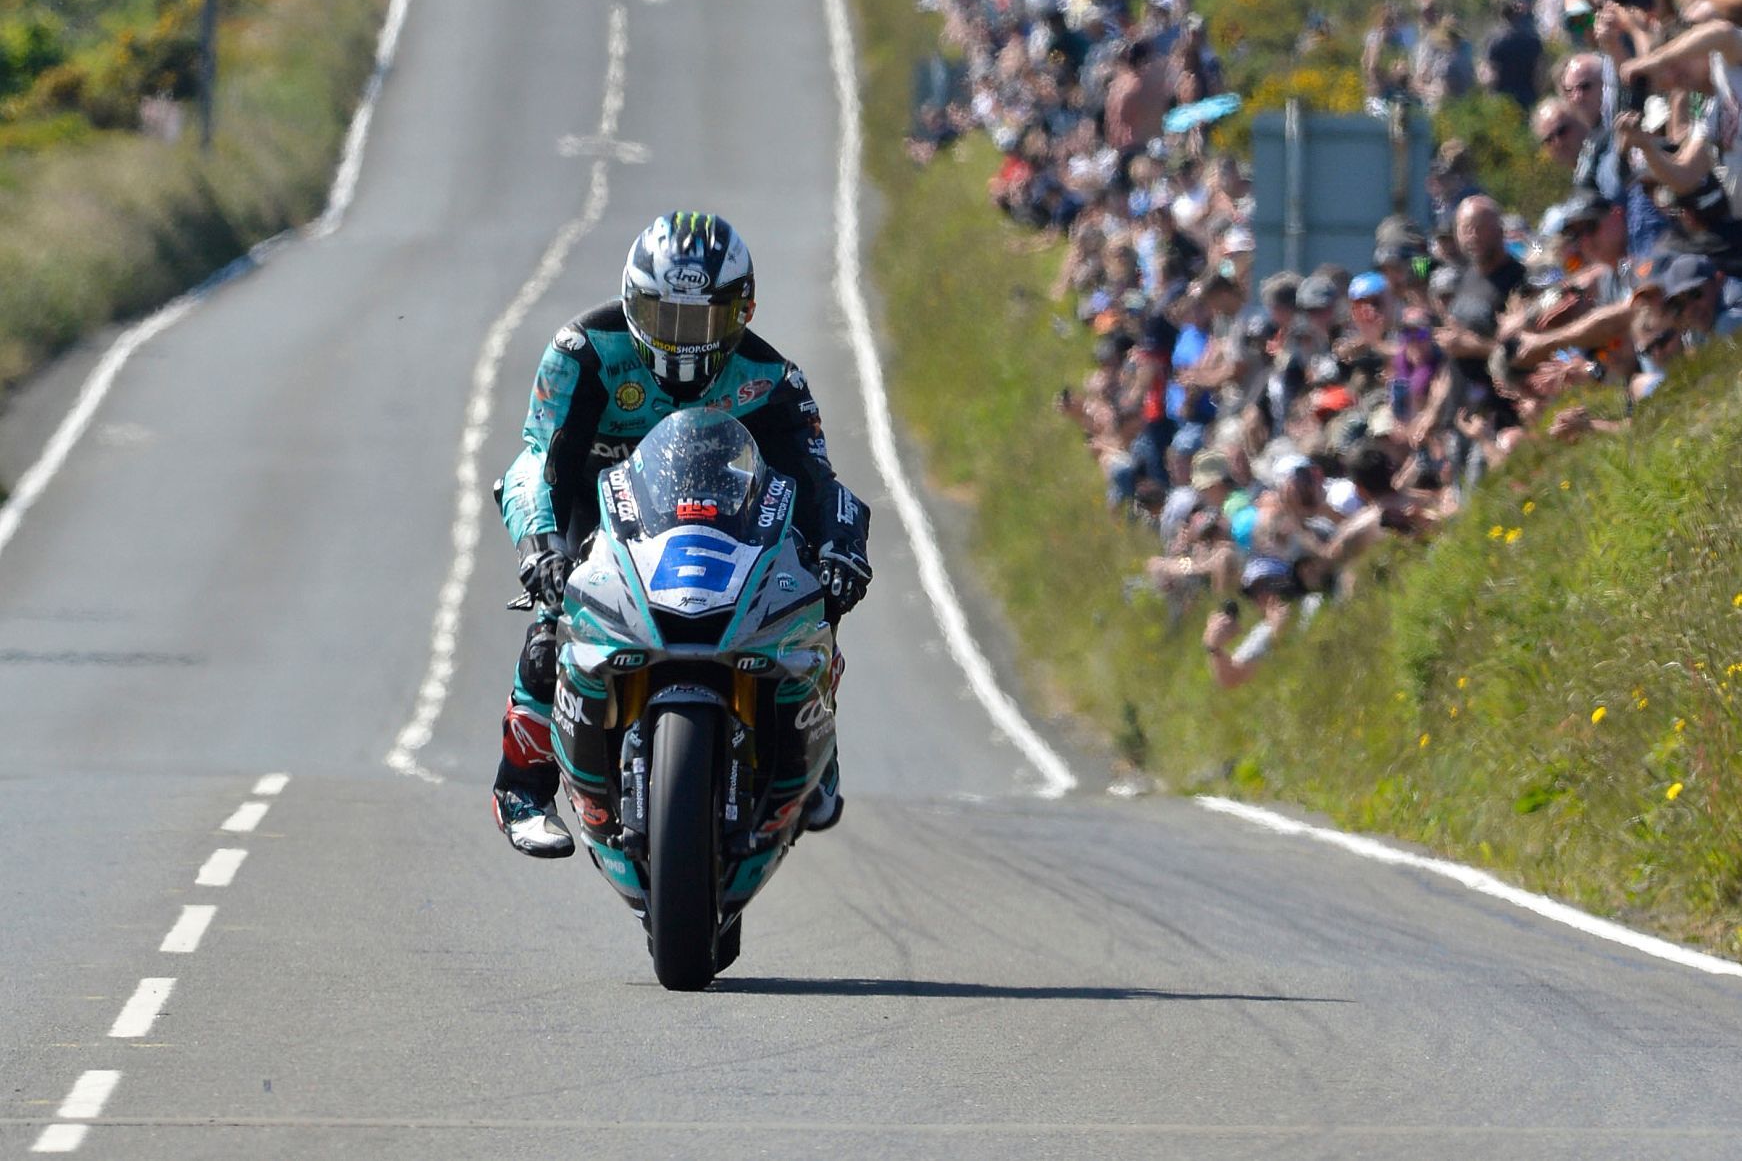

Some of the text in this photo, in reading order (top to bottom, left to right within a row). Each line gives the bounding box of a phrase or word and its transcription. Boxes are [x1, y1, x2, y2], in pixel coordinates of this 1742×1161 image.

[758, 476, 788, 527] carl cox
[650, 534, 738, 592] 6
